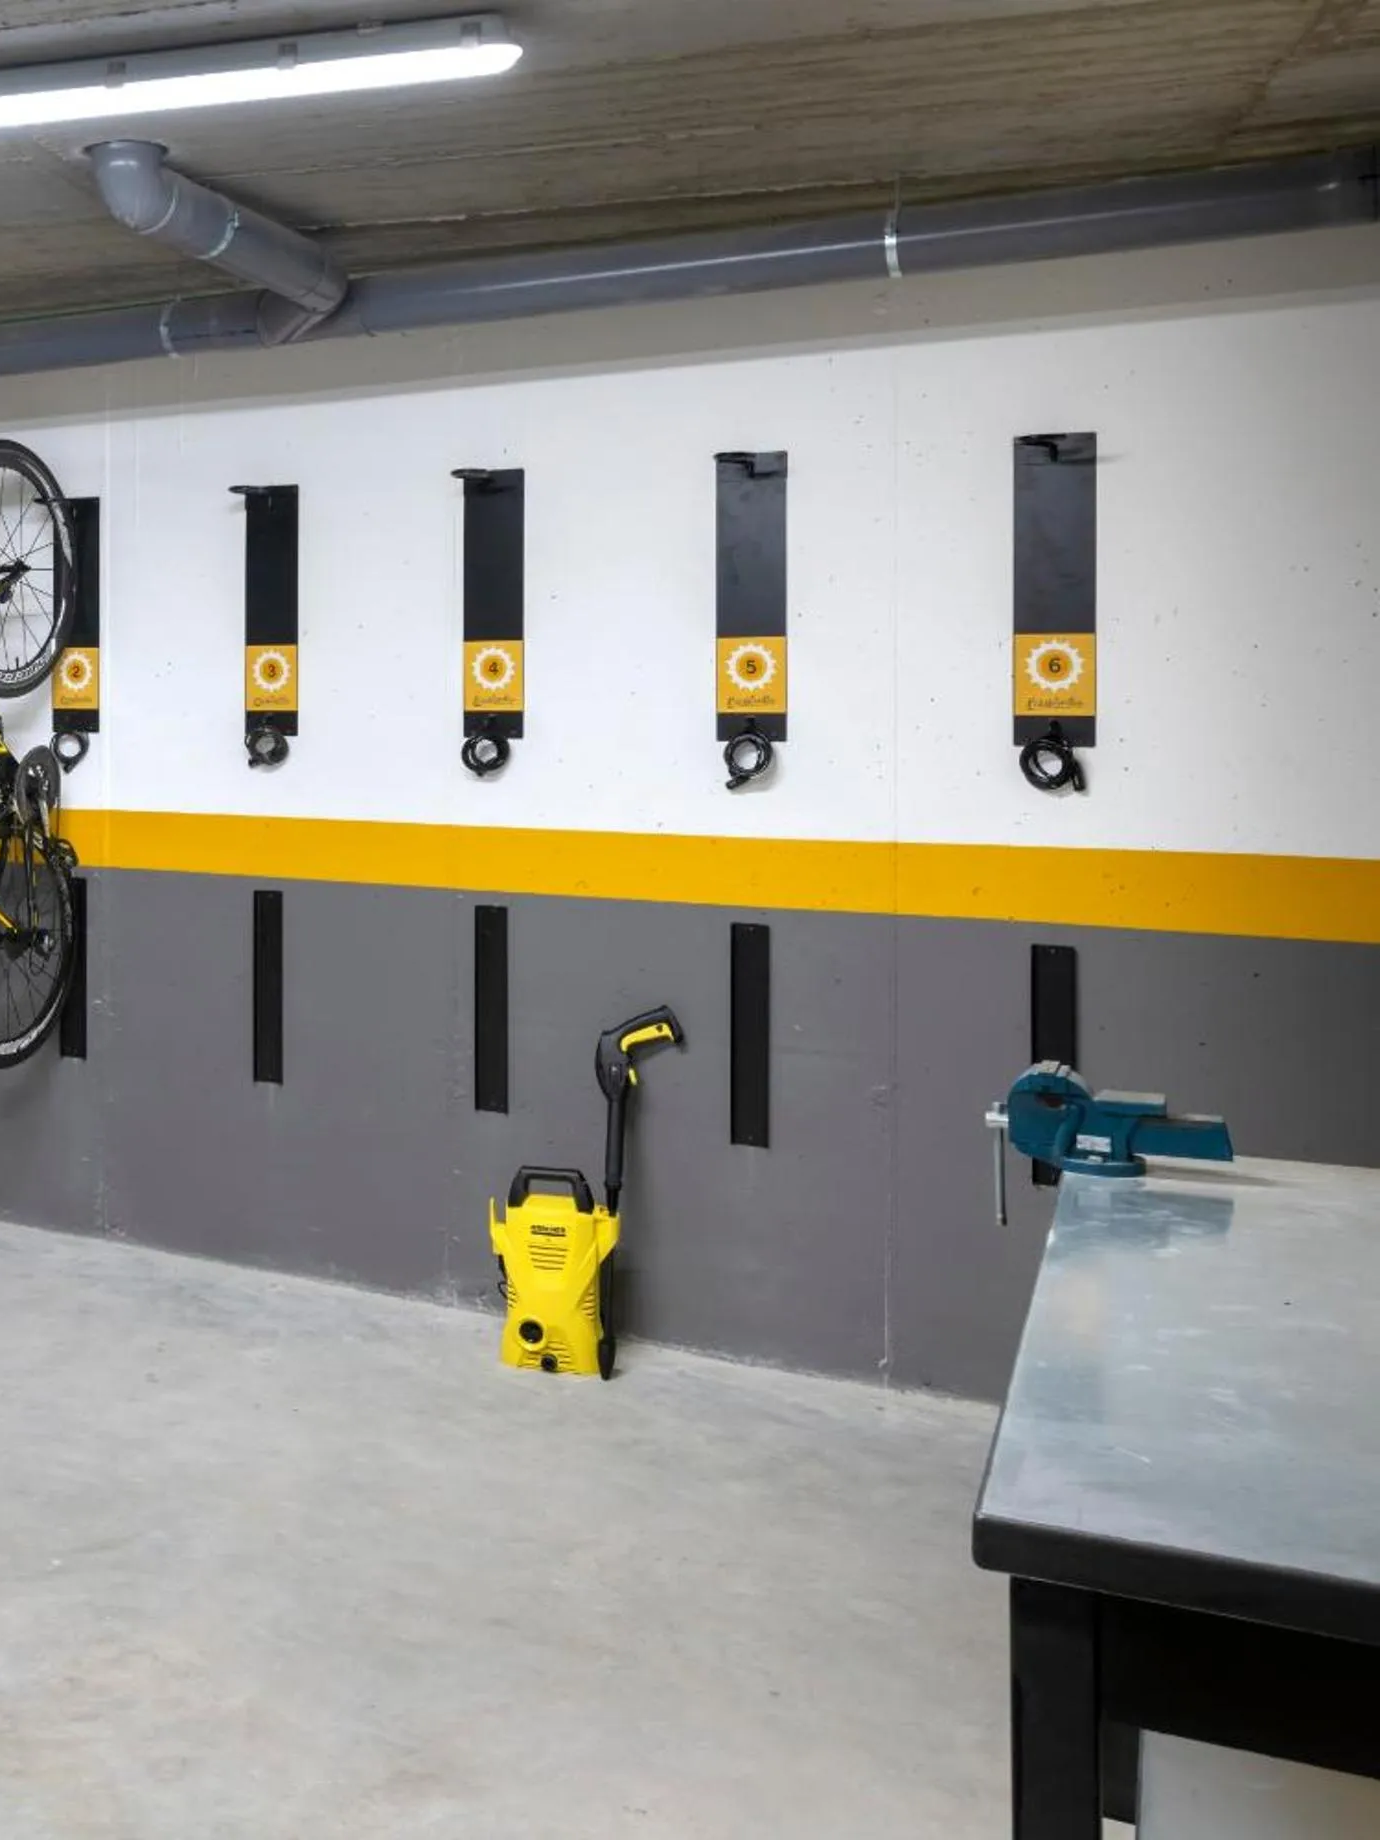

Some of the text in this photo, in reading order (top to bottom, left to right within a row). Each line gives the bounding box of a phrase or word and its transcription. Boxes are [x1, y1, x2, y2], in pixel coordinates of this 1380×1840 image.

[71, 665, 80, 678] 2
[267, 663, 277, 678] 3
[488, 661, 499, 675] 4
[747, 660, 757, 674] 5
[1048, 657, 1061, 674] 6
